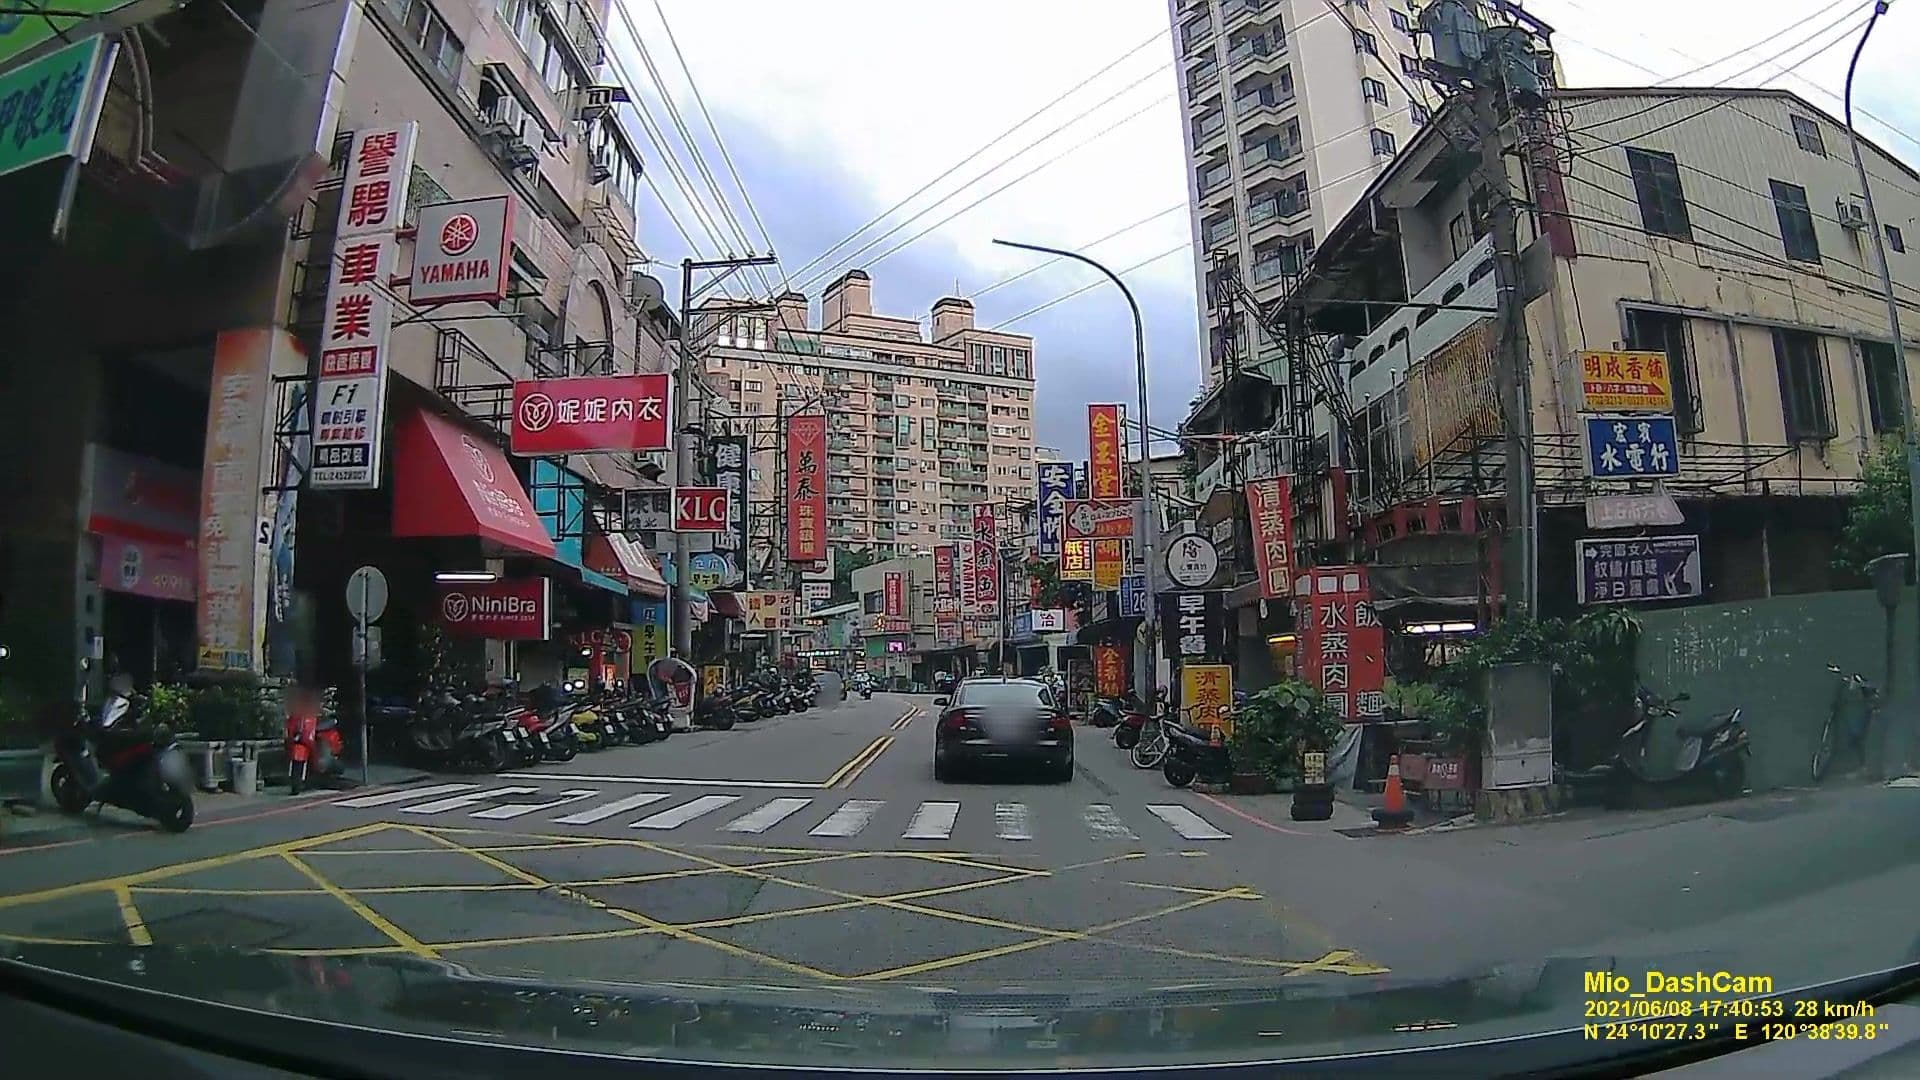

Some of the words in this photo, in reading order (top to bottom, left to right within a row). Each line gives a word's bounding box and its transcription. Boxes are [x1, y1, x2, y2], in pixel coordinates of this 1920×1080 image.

[420, 259, 490, 285] YAMAHA
[556, 395, 663, 424] 妮妮內衣
[1600, 442, 1669, 472] 水電行
[1254, 480, 1290, 595] 清蒸肉圓
[963, 557, 976, 607] YAMAHA
[471, 596, 536, 613] NiniBra
[1355, 601, 1383, 628] 飯
[1179, 594, 1207, 655] 早午餐
[1195, 671, 1222, 731] 清蒸肉
